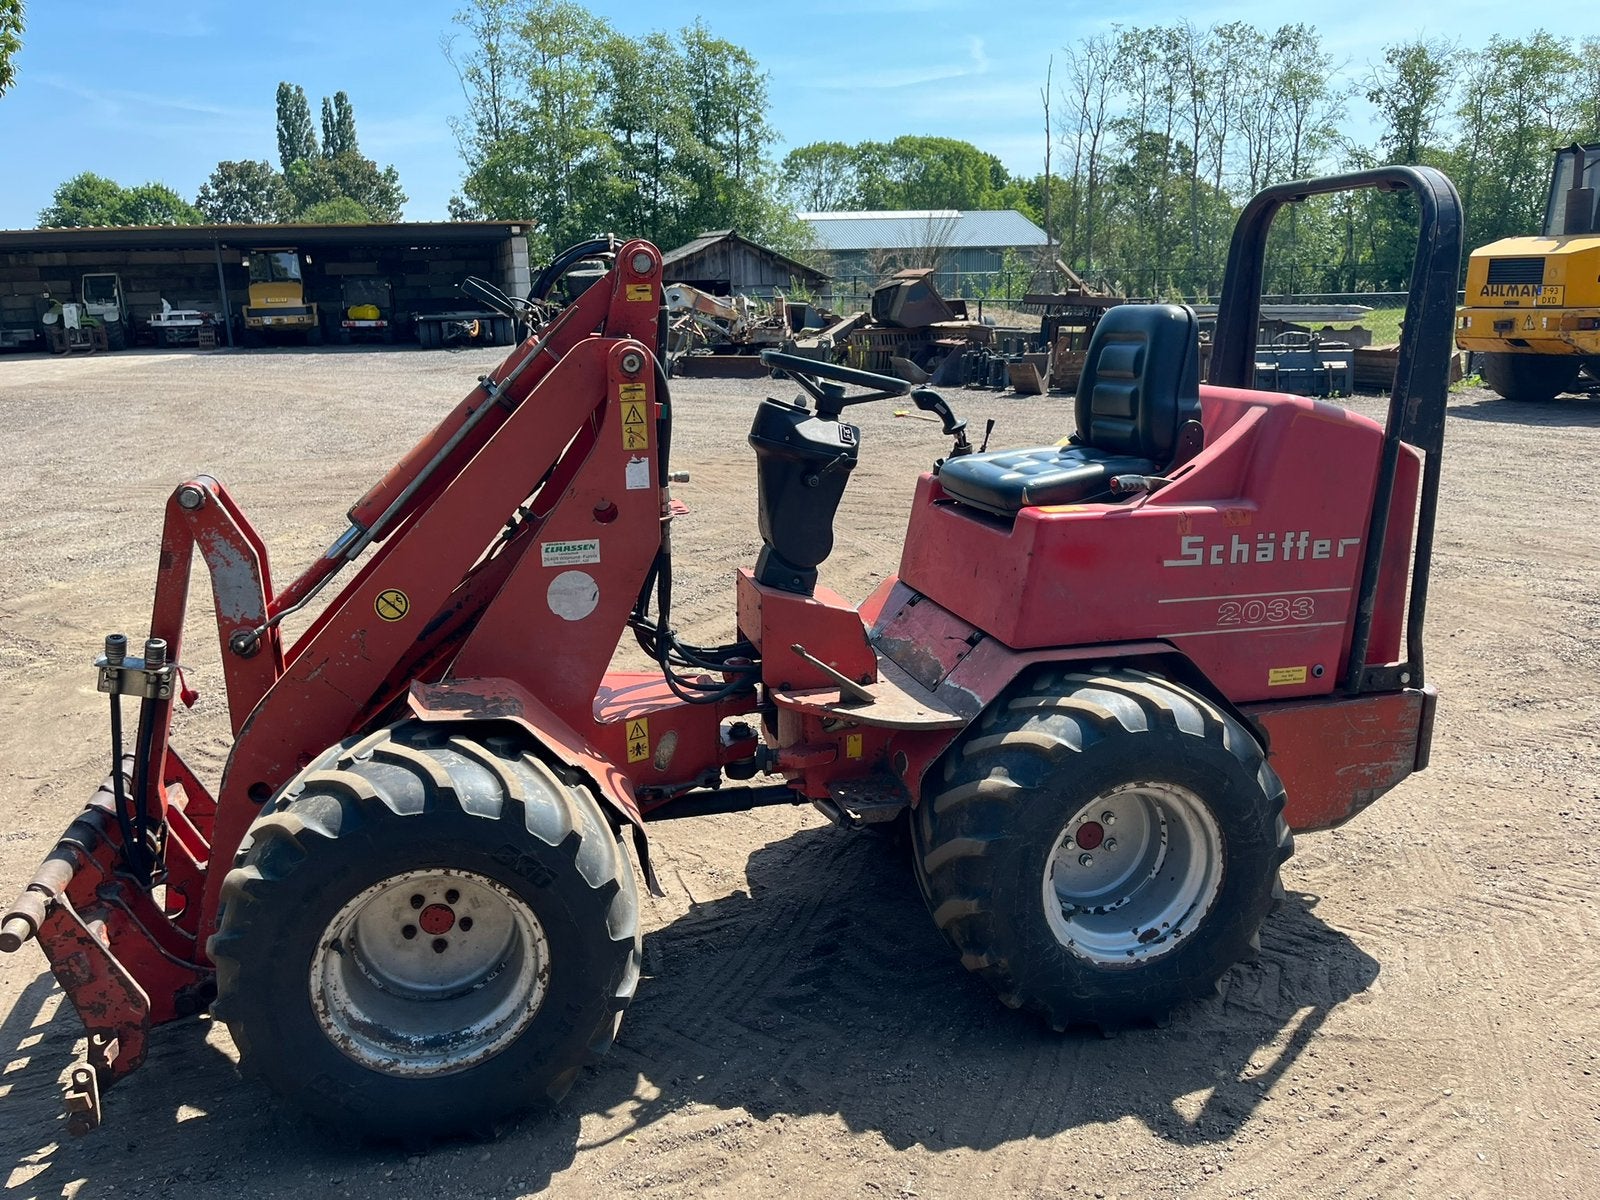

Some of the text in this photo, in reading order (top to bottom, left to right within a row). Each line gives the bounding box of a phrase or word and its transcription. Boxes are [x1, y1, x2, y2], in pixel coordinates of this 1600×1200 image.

[1543, 286, 1559, 295] T-93
[1163, 530, 1361, 567] Schäffer
[1217, 597, 1315, 626] 2033
